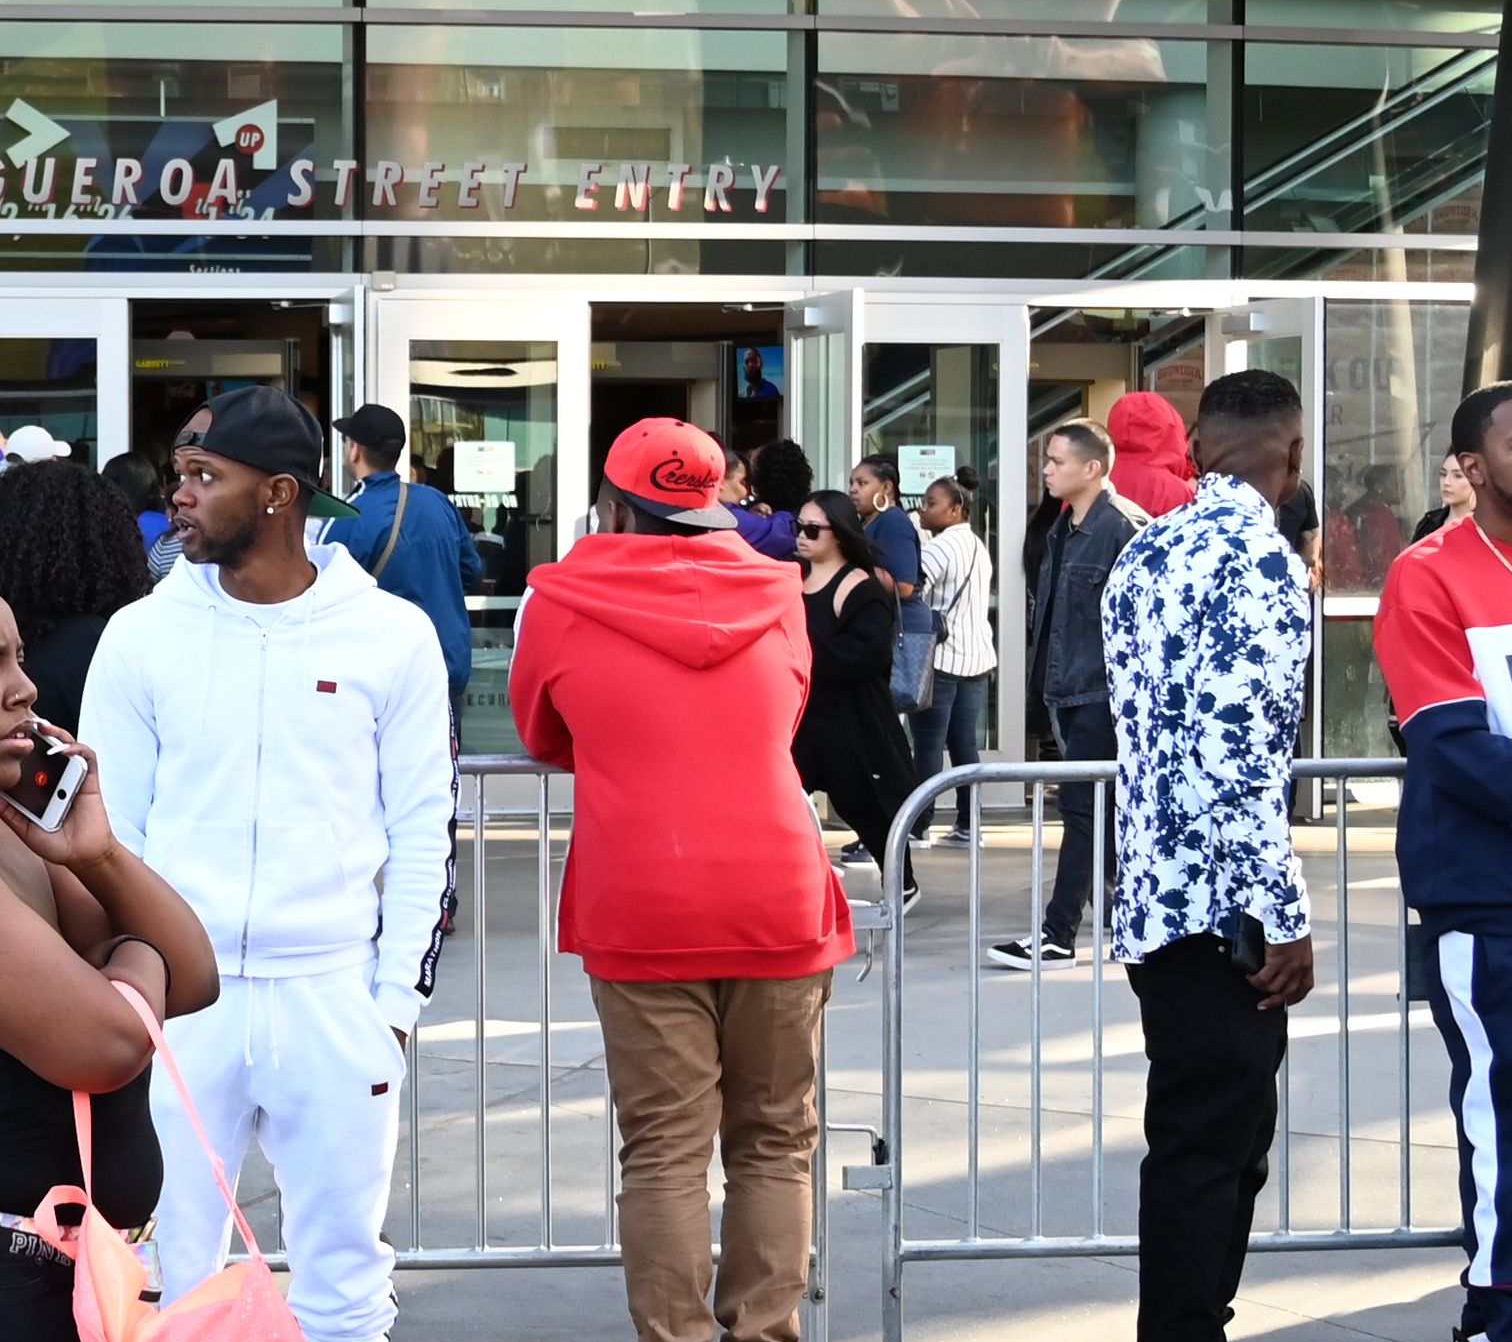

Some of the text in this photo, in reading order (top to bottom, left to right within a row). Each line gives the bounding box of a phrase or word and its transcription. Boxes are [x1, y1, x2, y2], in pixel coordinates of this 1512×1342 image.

[239, 131, 261, 148] UP
[287, 159, 527, 210] STREET
[575, 163, 780, 213] ENTRY
[467, 693, 511, 707] ECUR
[424, 929, 443, 988] MARATHON
